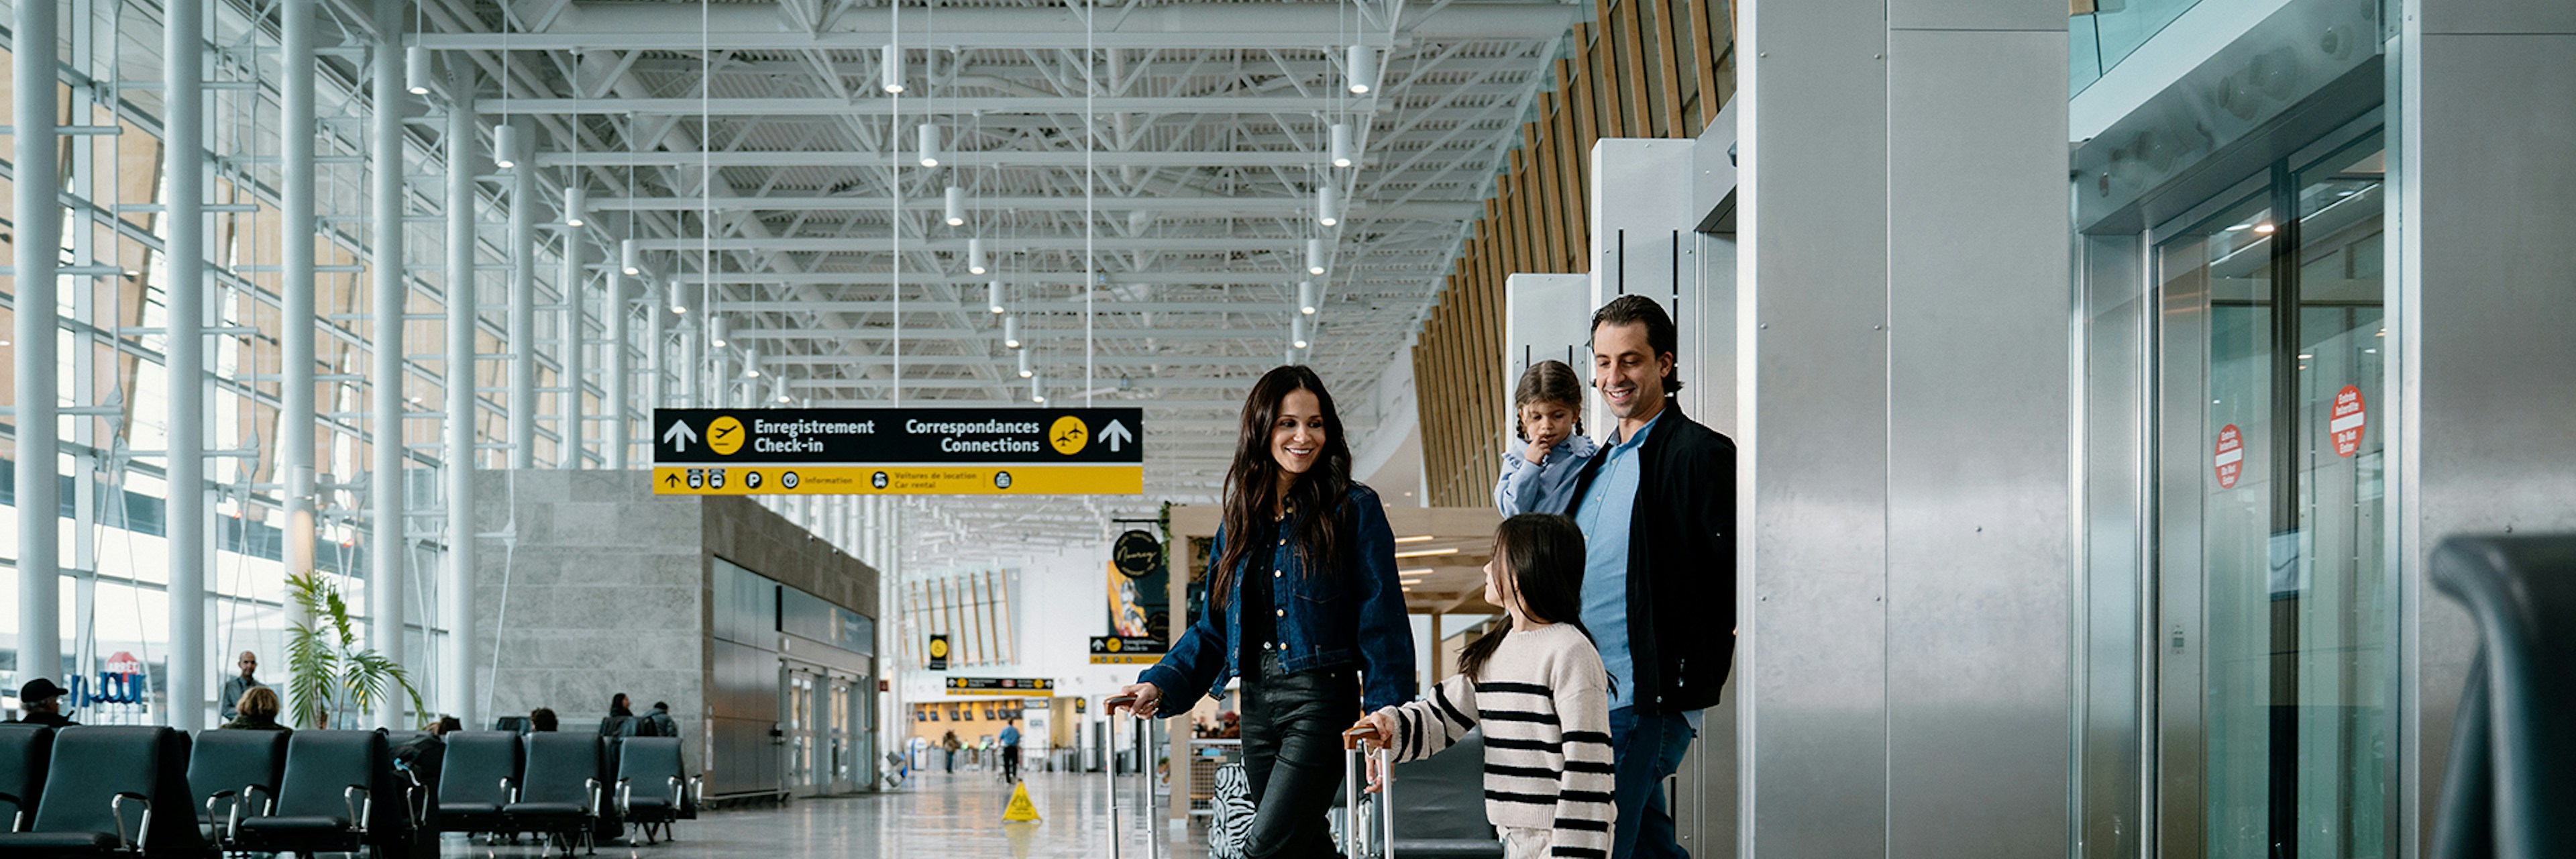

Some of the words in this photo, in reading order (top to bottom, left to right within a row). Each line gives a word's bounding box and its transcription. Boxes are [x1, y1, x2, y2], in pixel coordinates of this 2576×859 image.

[754, 419, 875, 438] Enregistrement
[906, 419, 1040, 437] Correspondances
[754, 437, 824, 453] Check-in
[941, 437, 1040, 452] Connections
[804, 476, 853, 484] Information
